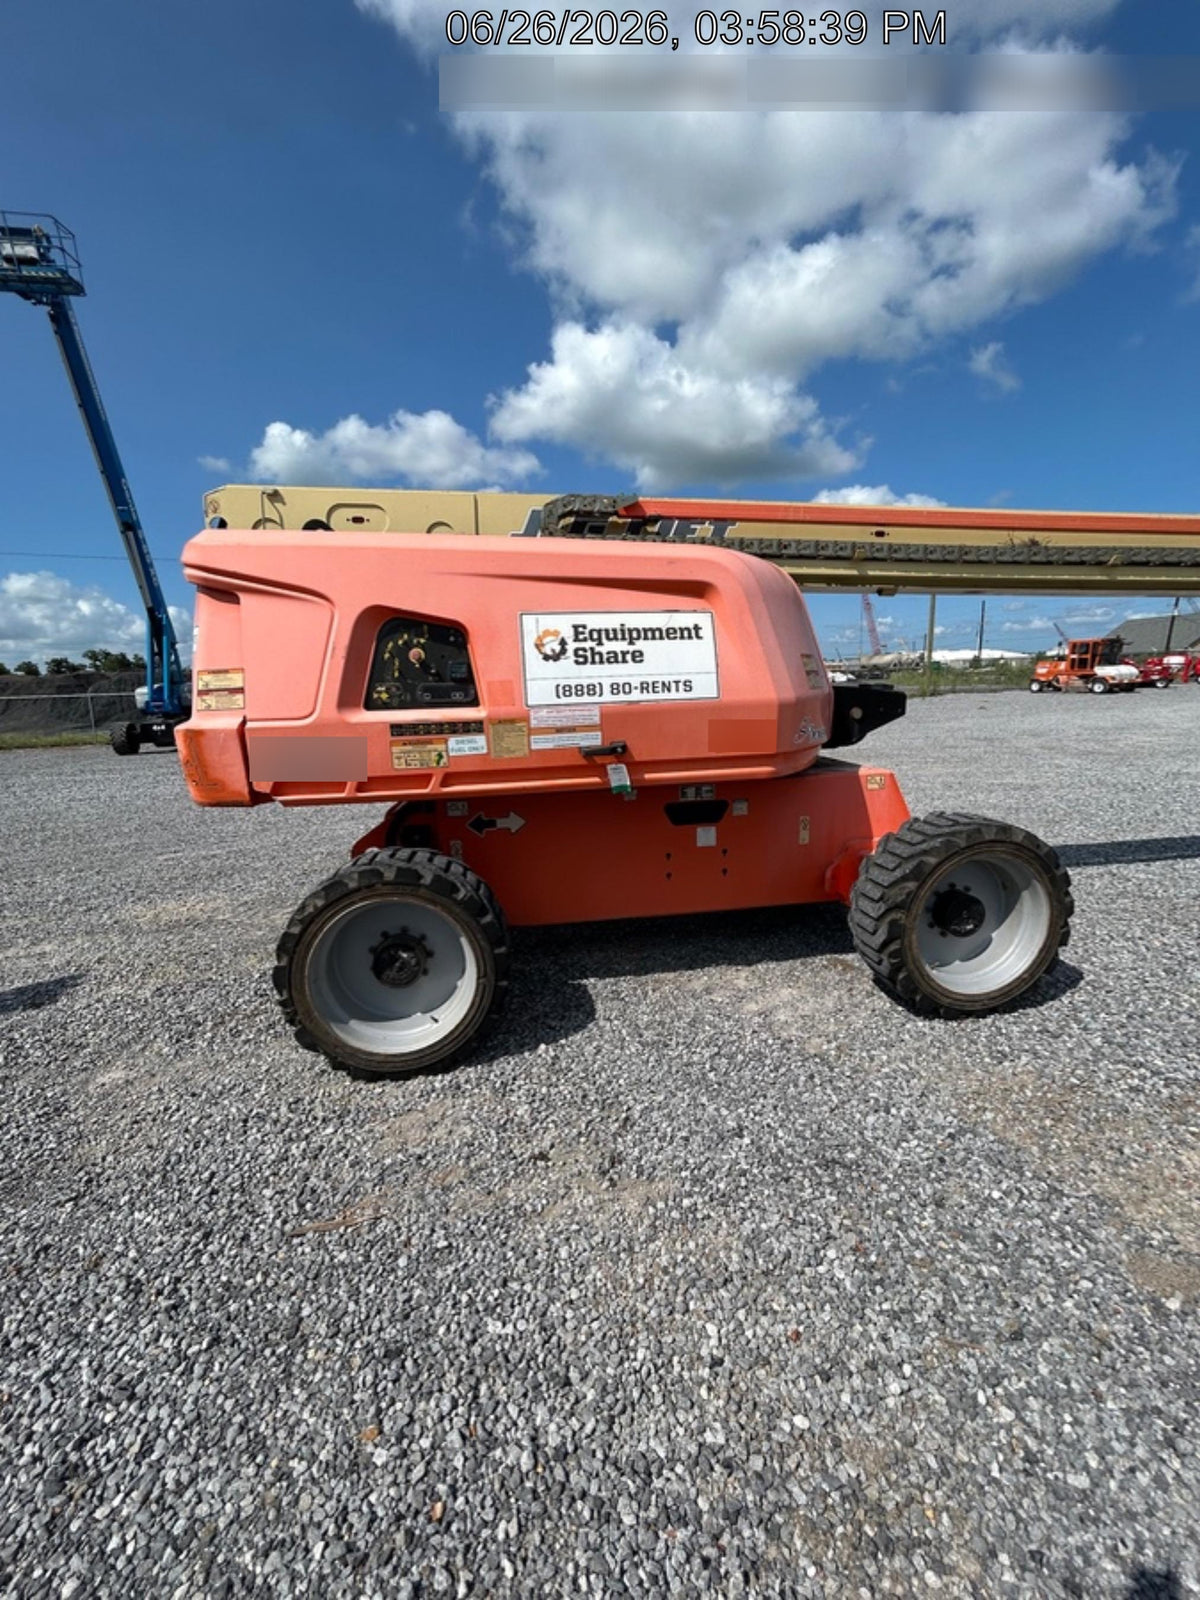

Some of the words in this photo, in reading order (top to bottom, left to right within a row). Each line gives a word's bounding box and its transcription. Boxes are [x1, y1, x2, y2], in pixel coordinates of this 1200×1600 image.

[572, 623, 704, 646] Equipment
[573, 646, 645, 666] Share
[555, 682, 603, 699] (888)
[609, 679, 694, 697] 80-RENTS
